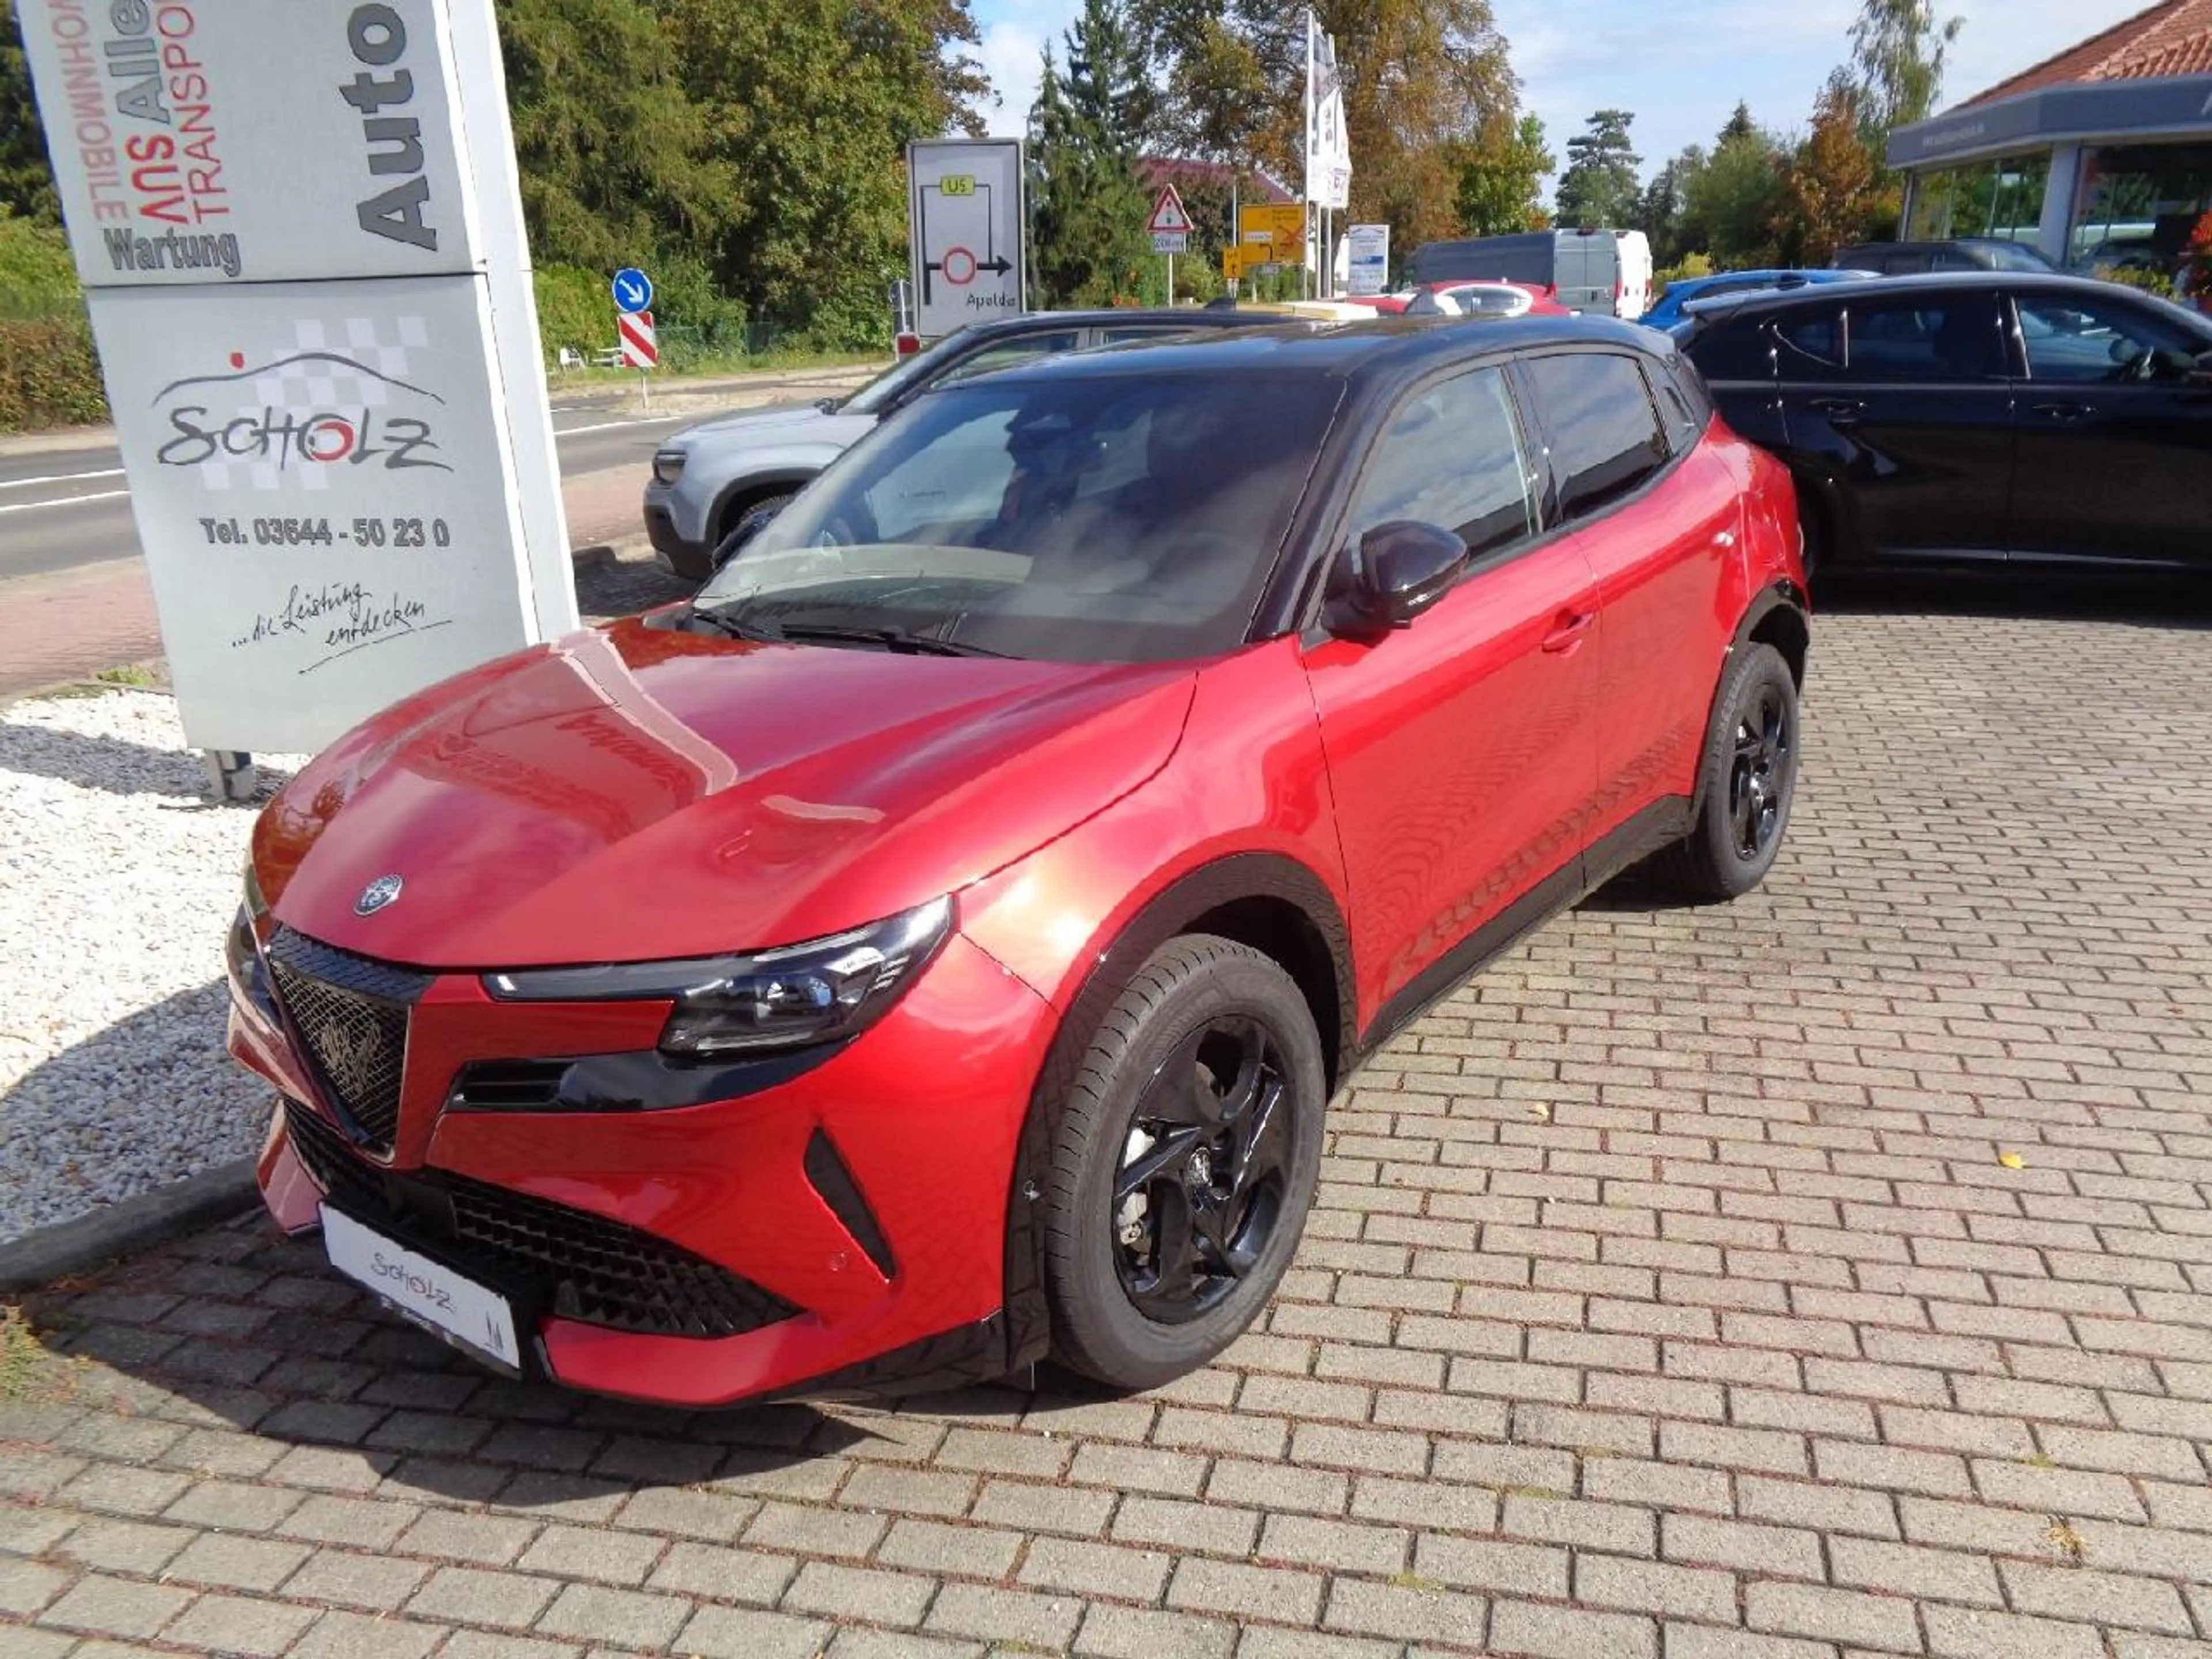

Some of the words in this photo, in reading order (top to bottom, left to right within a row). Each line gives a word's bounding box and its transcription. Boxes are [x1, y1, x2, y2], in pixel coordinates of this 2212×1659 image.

[154, 0, 230, 224] TRANSPO
[338, 2, 438, 252] Auto
[124, 134, 190, 225] SUV
[946, 179, 968, 194] U5
[103, 227, 242, 278] Wartung
[966, 292, 1016, 312] Apolda
[199, 518, 248, 544] Tel.
[253, 518, 333, 546] 03644
[353, 518, 387, 547] 50
[393, 518, 426, 547] 23
[432, 518, 450, 547] 0
[280, 582, 373, 634] Leistung
[325, 592, 425, 646] entdecken
